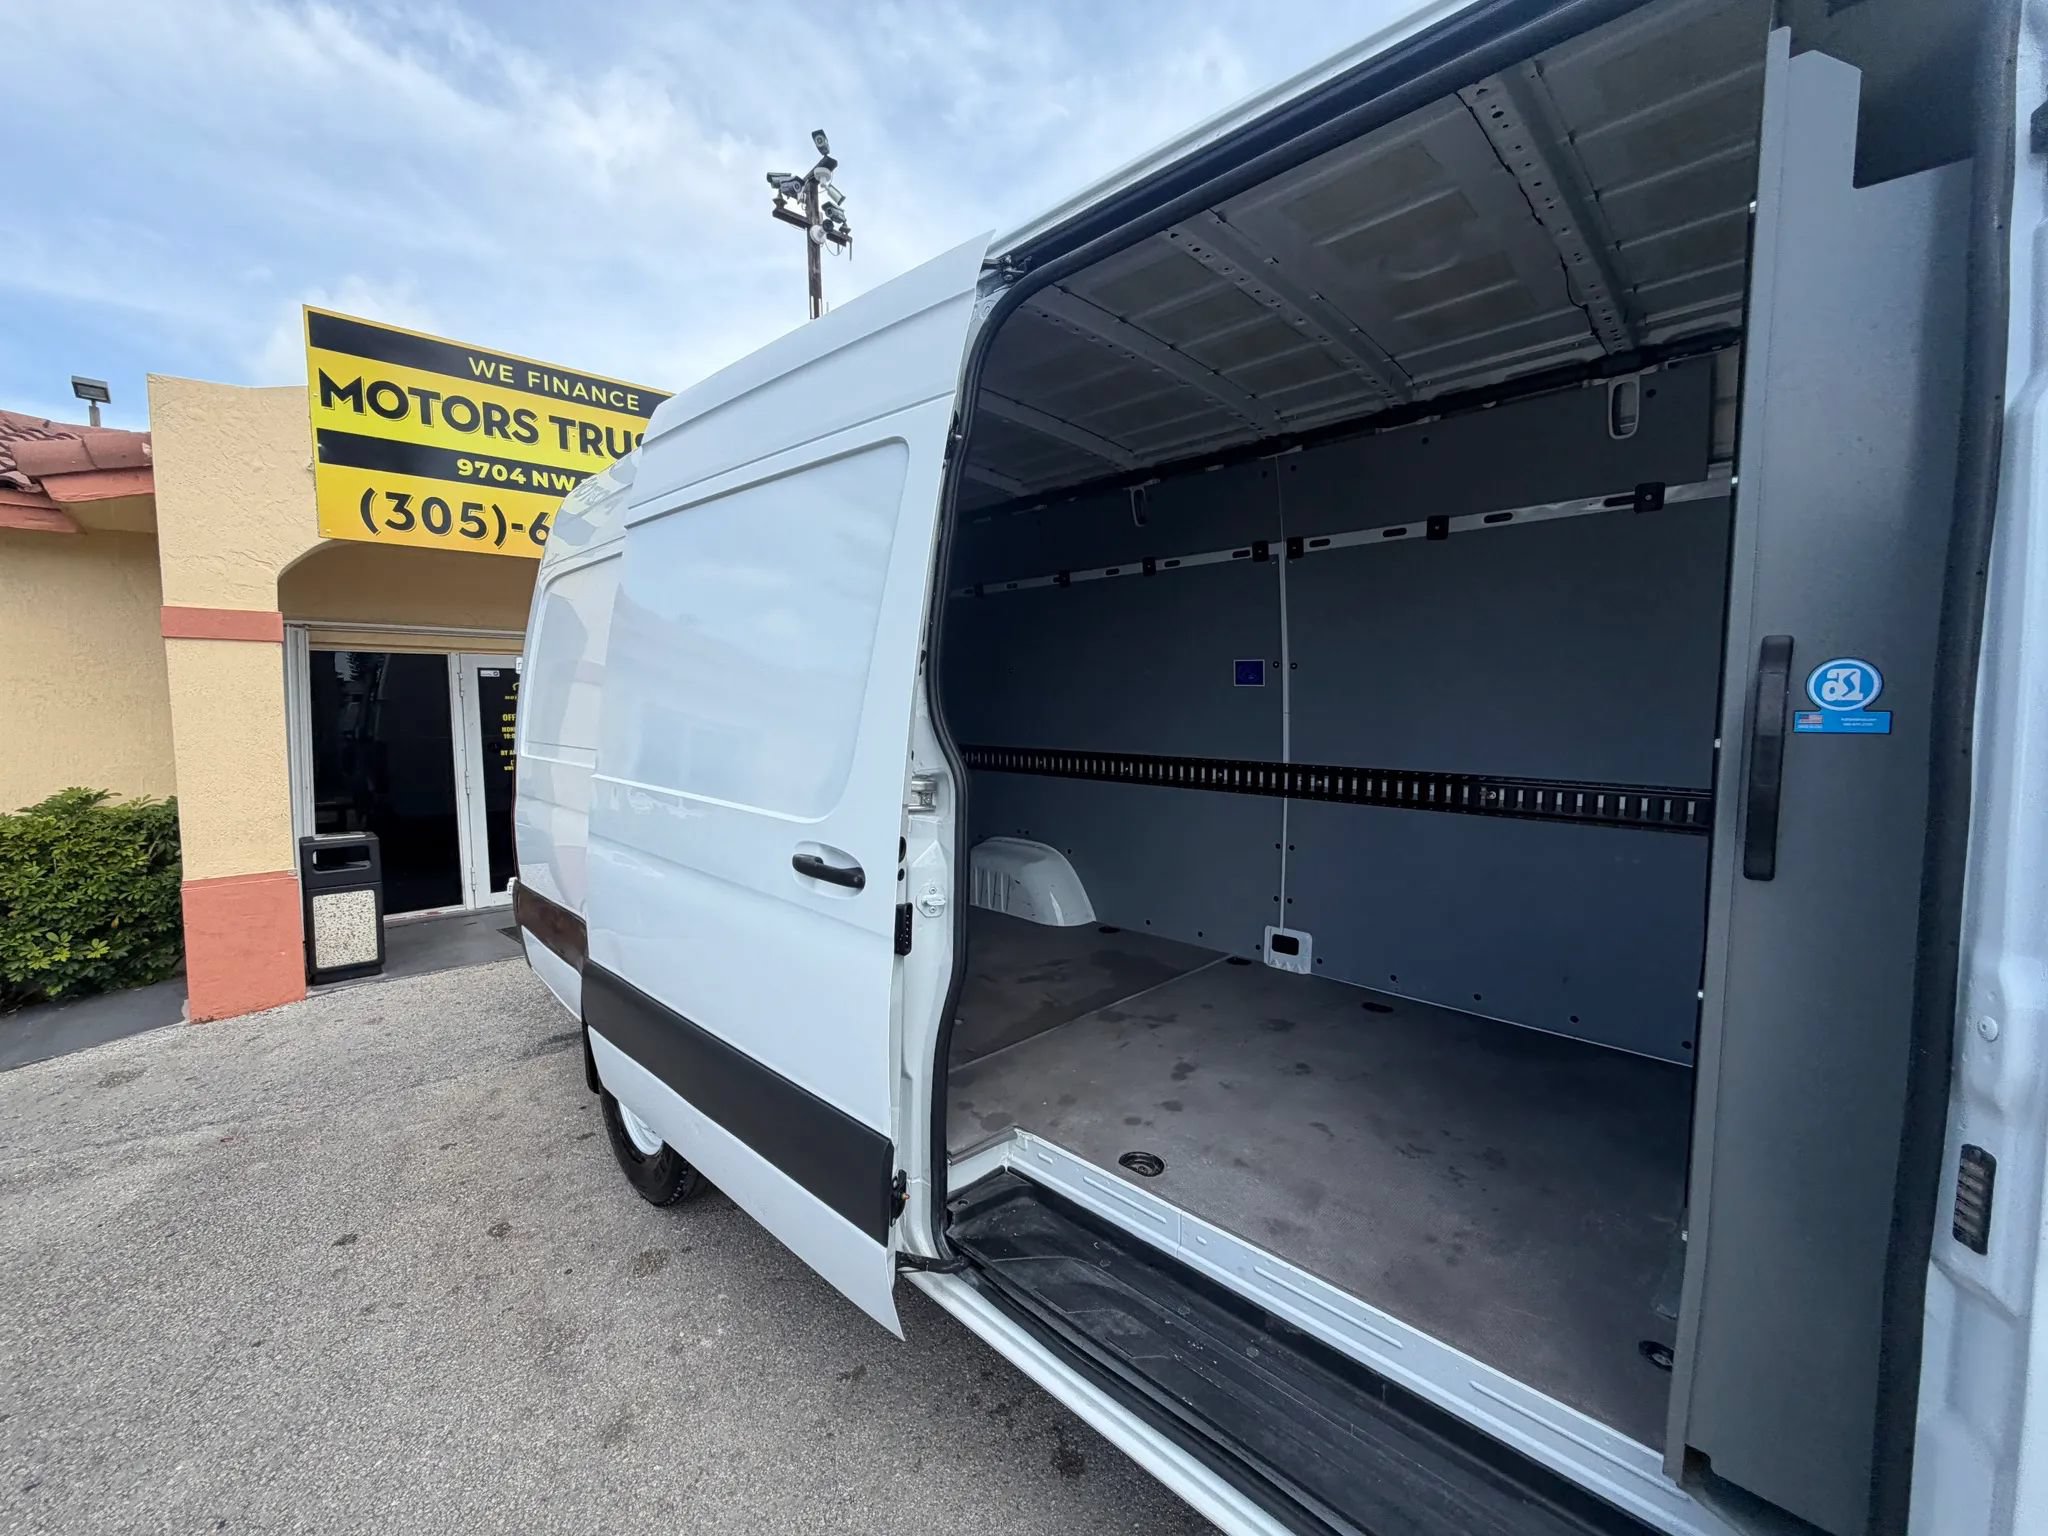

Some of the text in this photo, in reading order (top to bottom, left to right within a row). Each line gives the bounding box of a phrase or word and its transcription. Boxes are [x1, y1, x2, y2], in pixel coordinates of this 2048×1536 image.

[318, 367, 540, 445] MOTORS
[468, 356, 640, 411] WE FINANCE
[456, 458, 577, 492] 9704 NW
